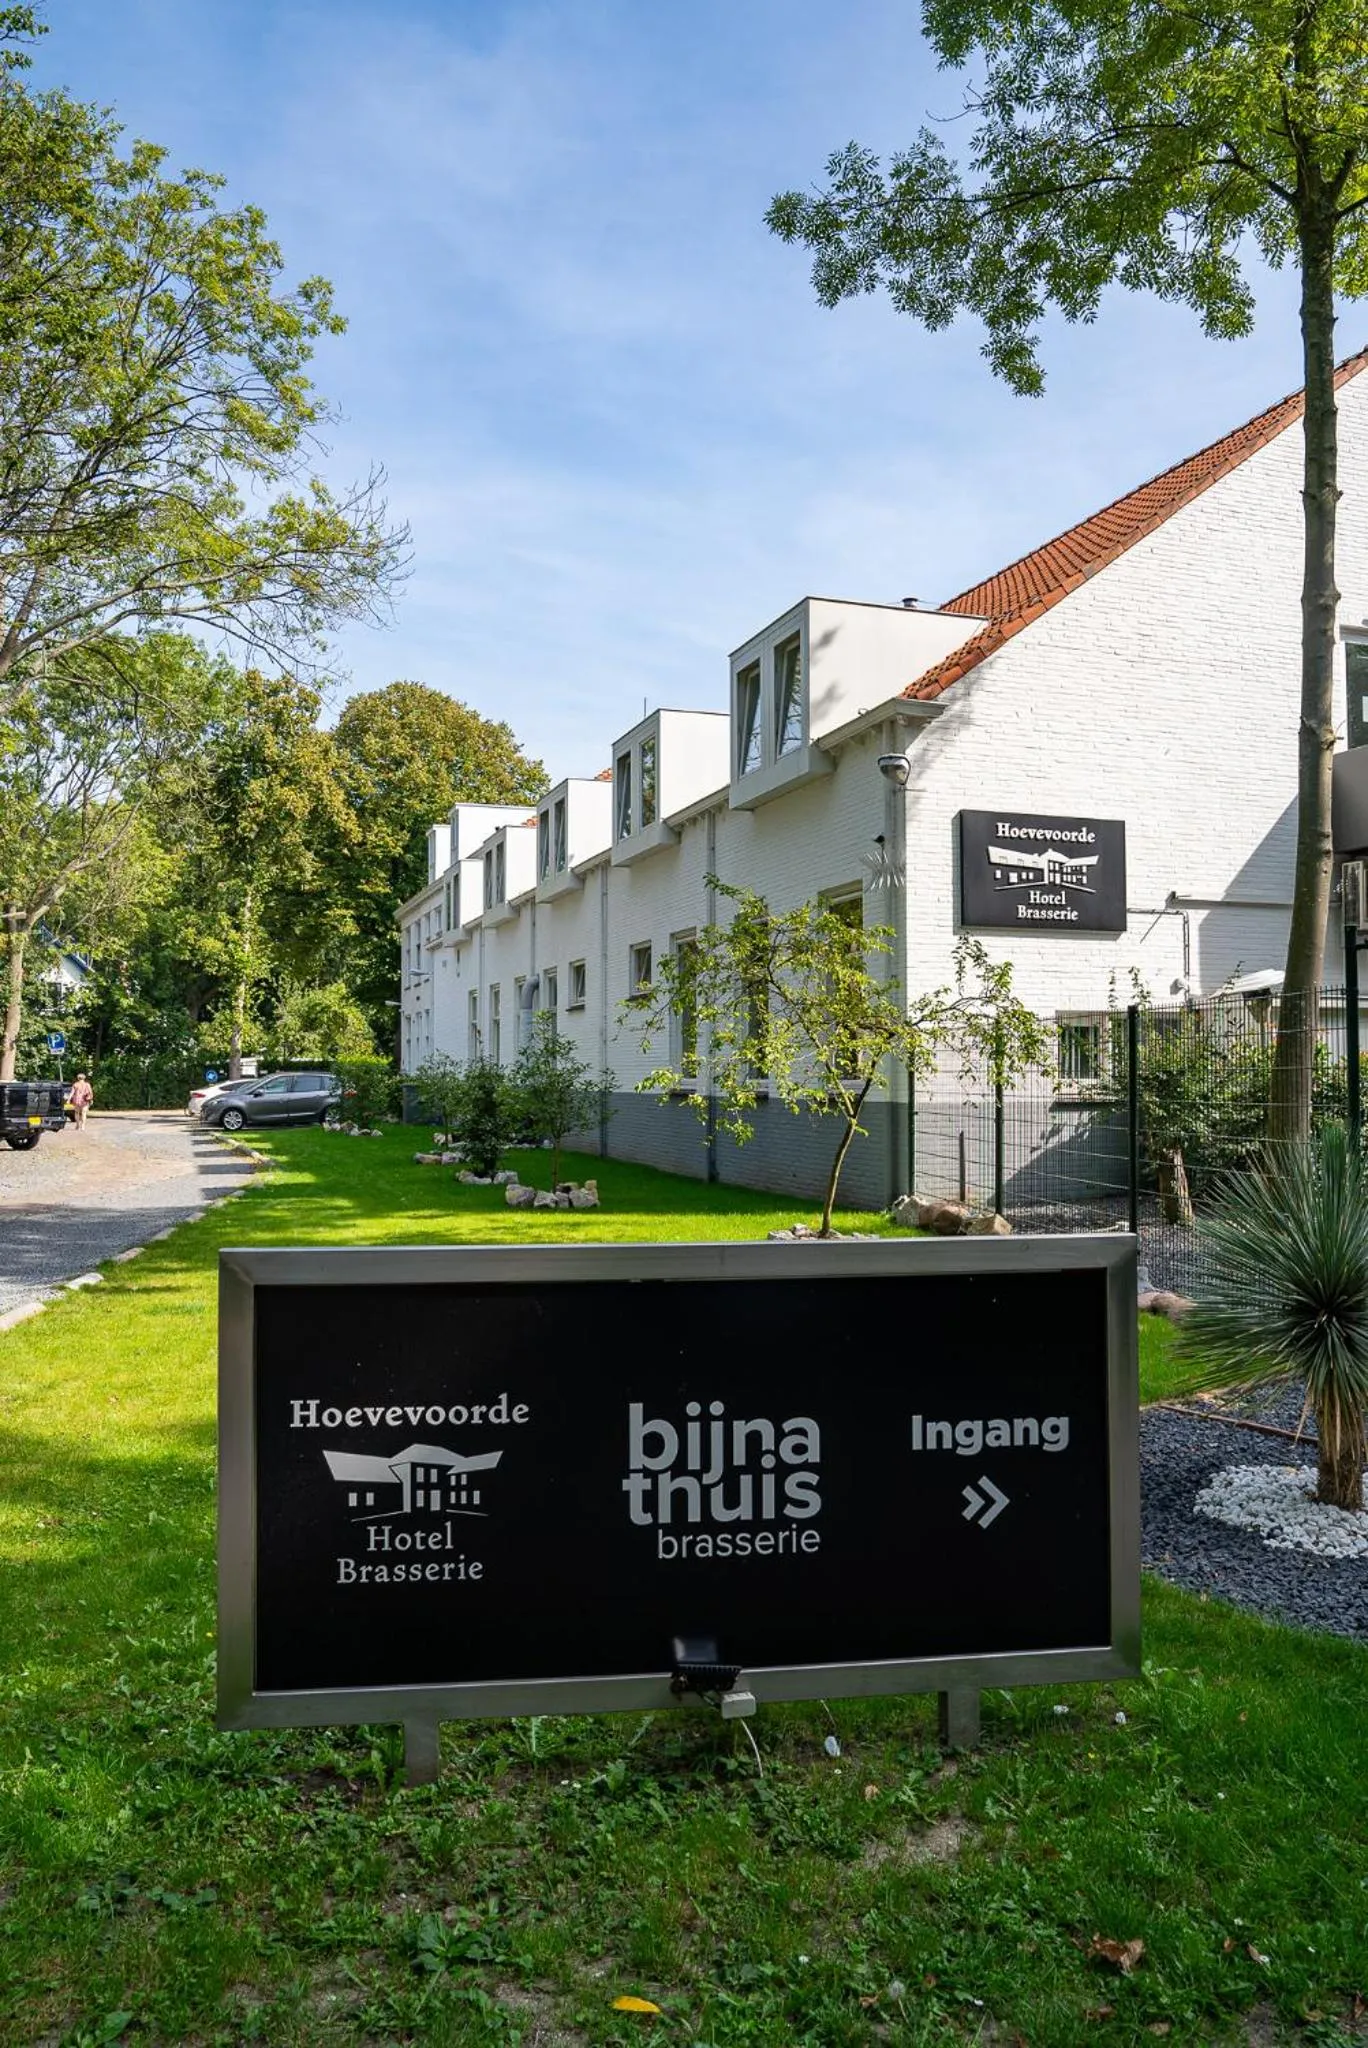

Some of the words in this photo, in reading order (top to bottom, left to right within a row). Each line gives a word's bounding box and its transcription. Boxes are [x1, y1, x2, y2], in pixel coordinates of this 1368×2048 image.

[996, 821, 1096, 843] Hoevevoorde
[1017, 904, 1079, 921] Brasserie
[1029, 890, 1067, 905] Hotel
[51, 1034, 62, 1048] P
[289, 1392, 530, 1428] Hoevevoorde
[628, 1400, 821, 1484] bijna
[911, 1414, 1070, 1456] Ingang
[622, 1454, 822, 1526] thuis
[366, 1521, 454, 1551] Hotel
[657, 1523, 821, 1559] brasserie
[336, 1554, 484, 1584] Brasserie
